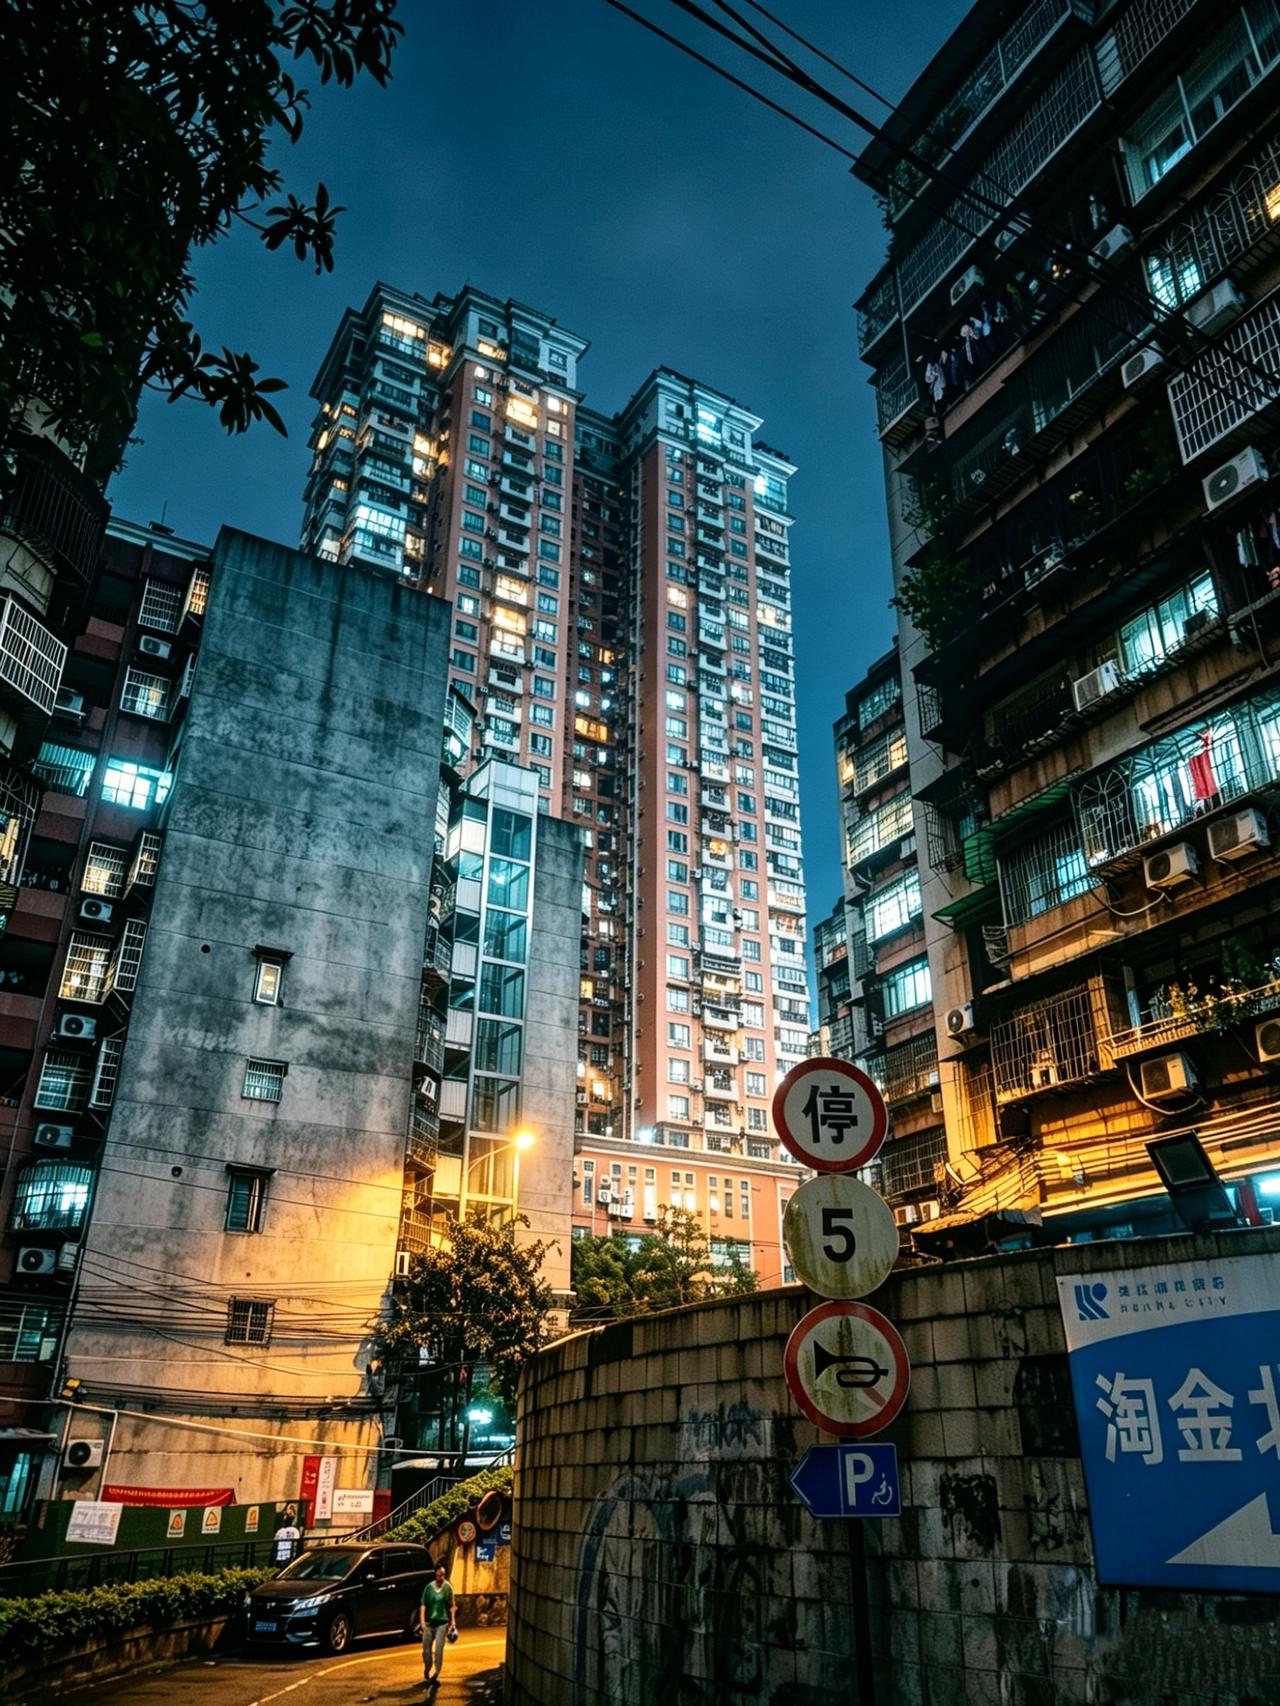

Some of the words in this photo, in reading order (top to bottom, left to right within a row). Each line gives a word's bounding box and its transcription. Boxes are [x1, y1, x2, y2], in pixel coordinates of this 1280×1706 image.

[802, 1085, 858, 1144] 停
[822, 1208, 855, 1263] 5
[845, 1453, 874, 1506] P
